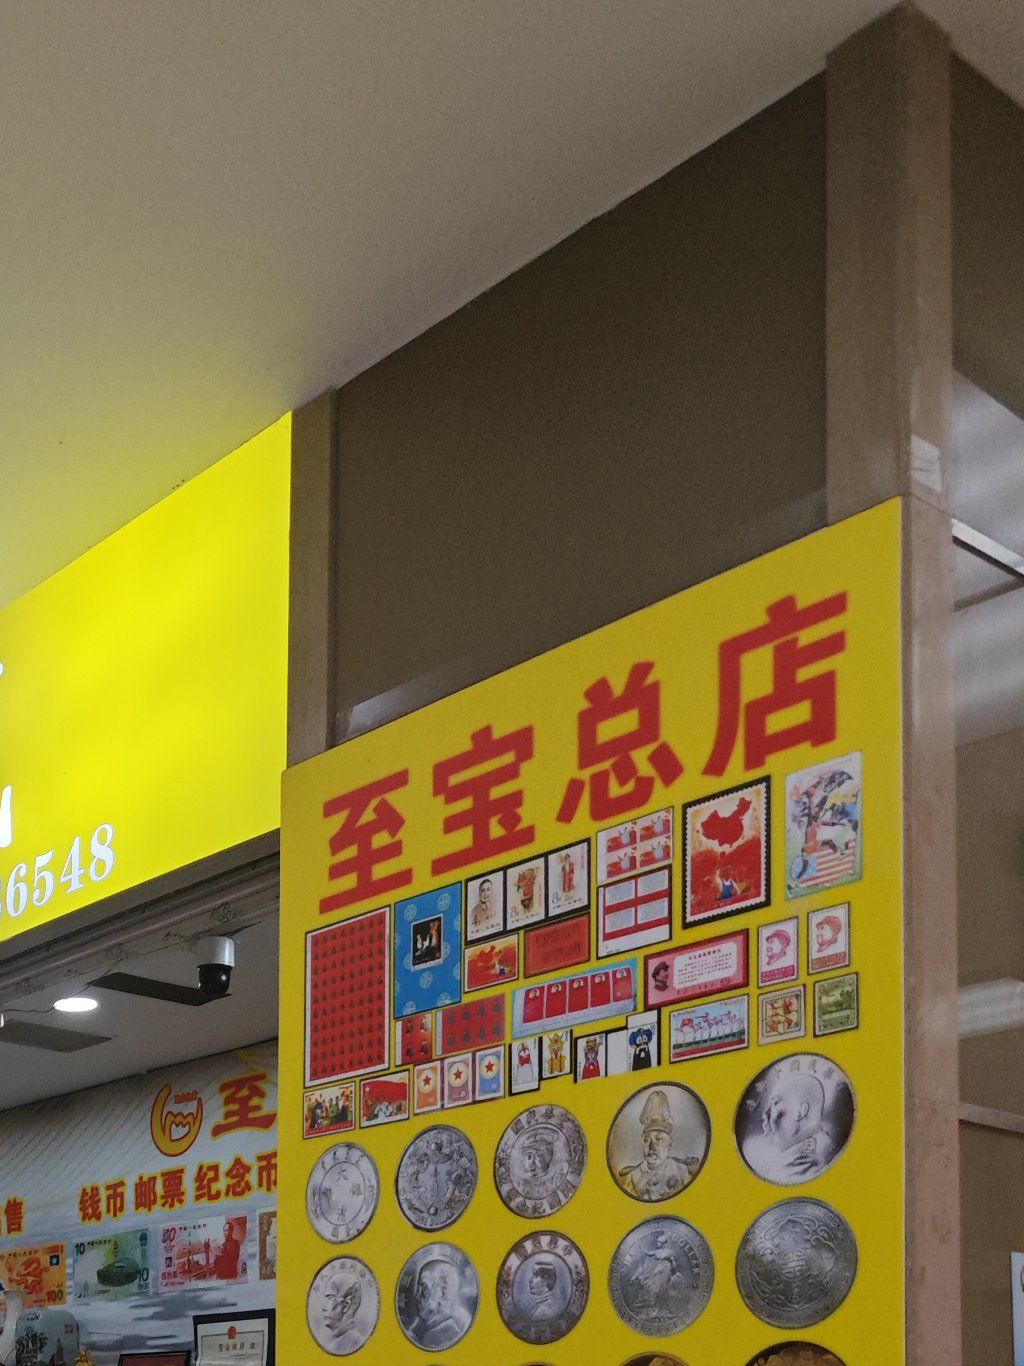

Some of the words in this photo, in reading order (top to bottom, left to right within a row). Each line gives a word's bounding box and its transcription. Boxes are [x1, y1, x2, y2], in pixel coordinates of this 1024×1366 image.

[319, 591, 848, 914] 至宝总店
[79, 1181, 126, 1223] 钱币
[134, 1166, 186, 1213] 邮票
